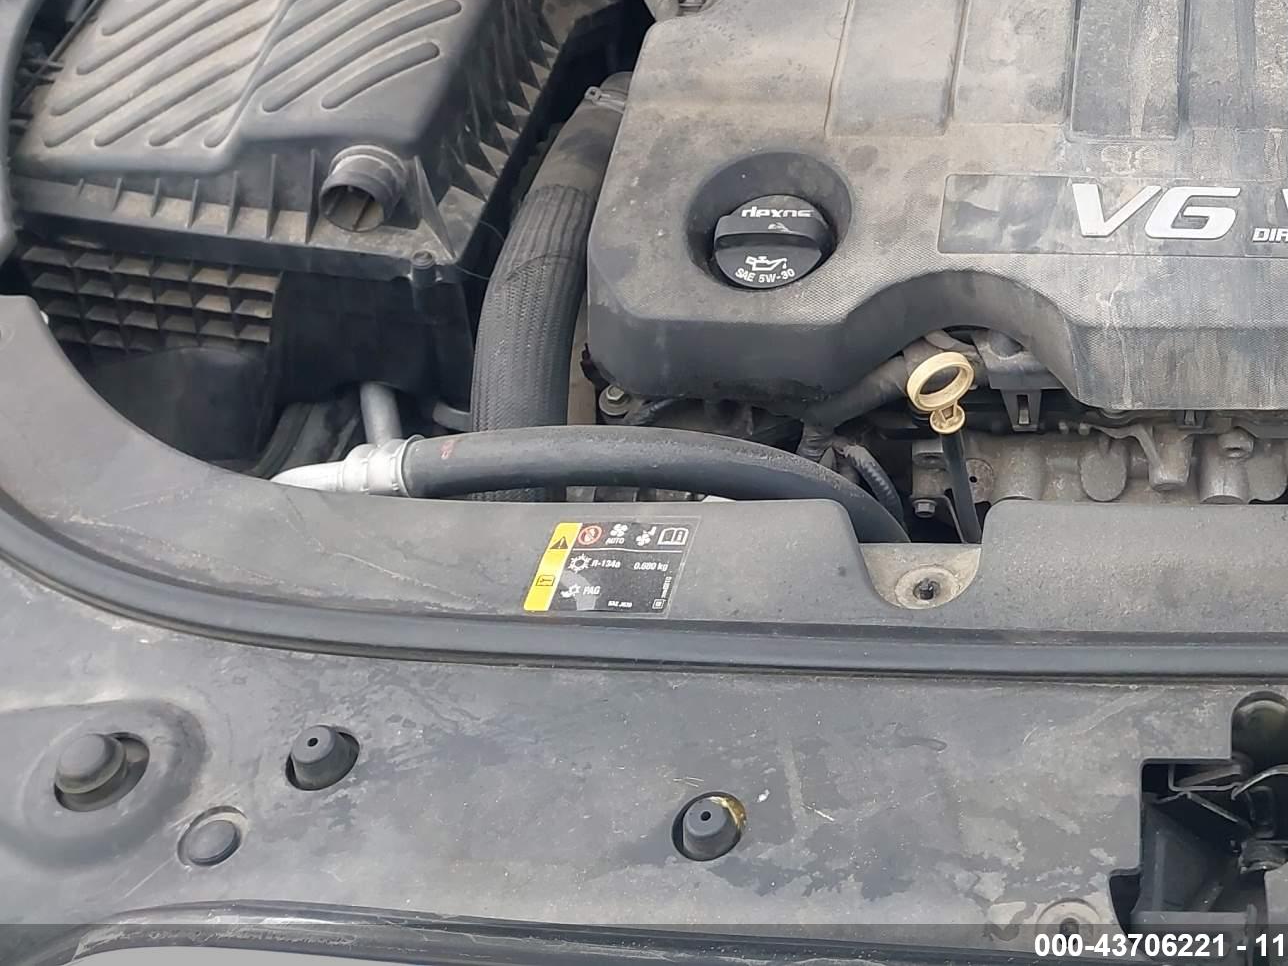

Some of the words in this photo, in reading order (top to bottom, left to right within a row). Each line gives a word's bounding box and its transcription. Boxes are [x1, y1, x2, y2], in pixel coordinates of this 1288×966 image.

[1071, 183, 1242, 240] V6
[735, 267, 756, 282] SAE
[758, 268, 796, 283] 5W-30
[657, 561, 668, 572] kg
[583, 585, 601, 595] PAG
